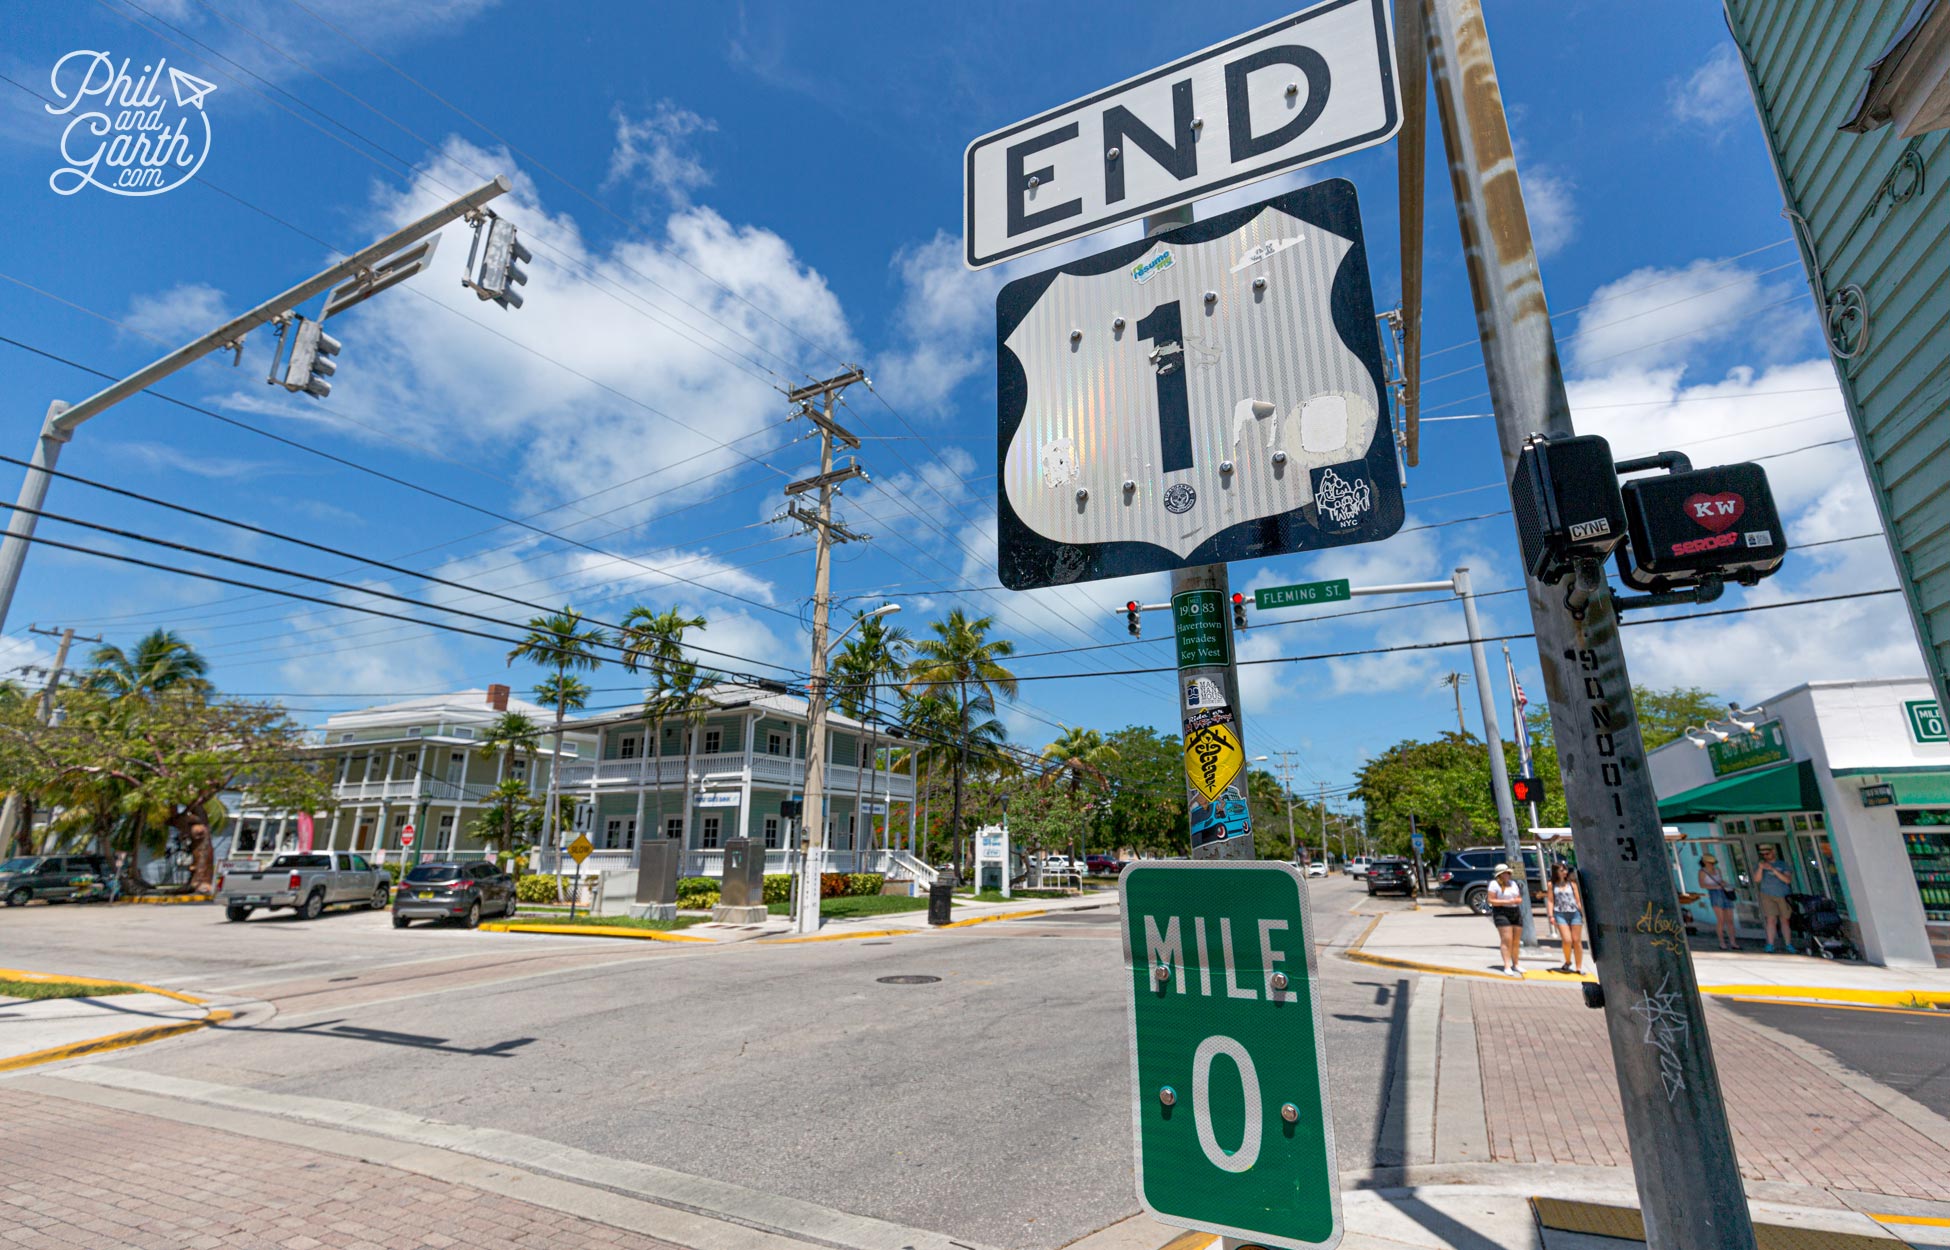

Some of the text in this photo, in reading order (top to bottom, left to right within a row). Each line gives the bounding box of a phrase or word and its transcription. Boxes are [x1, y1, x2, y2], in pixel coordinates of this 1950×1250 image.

[1007, 45, 1331, 239] END
[1136, 299, 1194, 474] 1
[1340, 520, 1358, 528] NYC
[1572, 520, 1608, 538] CYNE
[1263, 588, 1316, 604] FLEMING
[1177, 621, 1222, 633] Havertown
[1182, 634, 1216, 645] Invades
[1181, 648, 1221, 660] Key West
[1144, 914, 1298, 1003] MILE
[1192, 1035, 1263, 1173] 0
